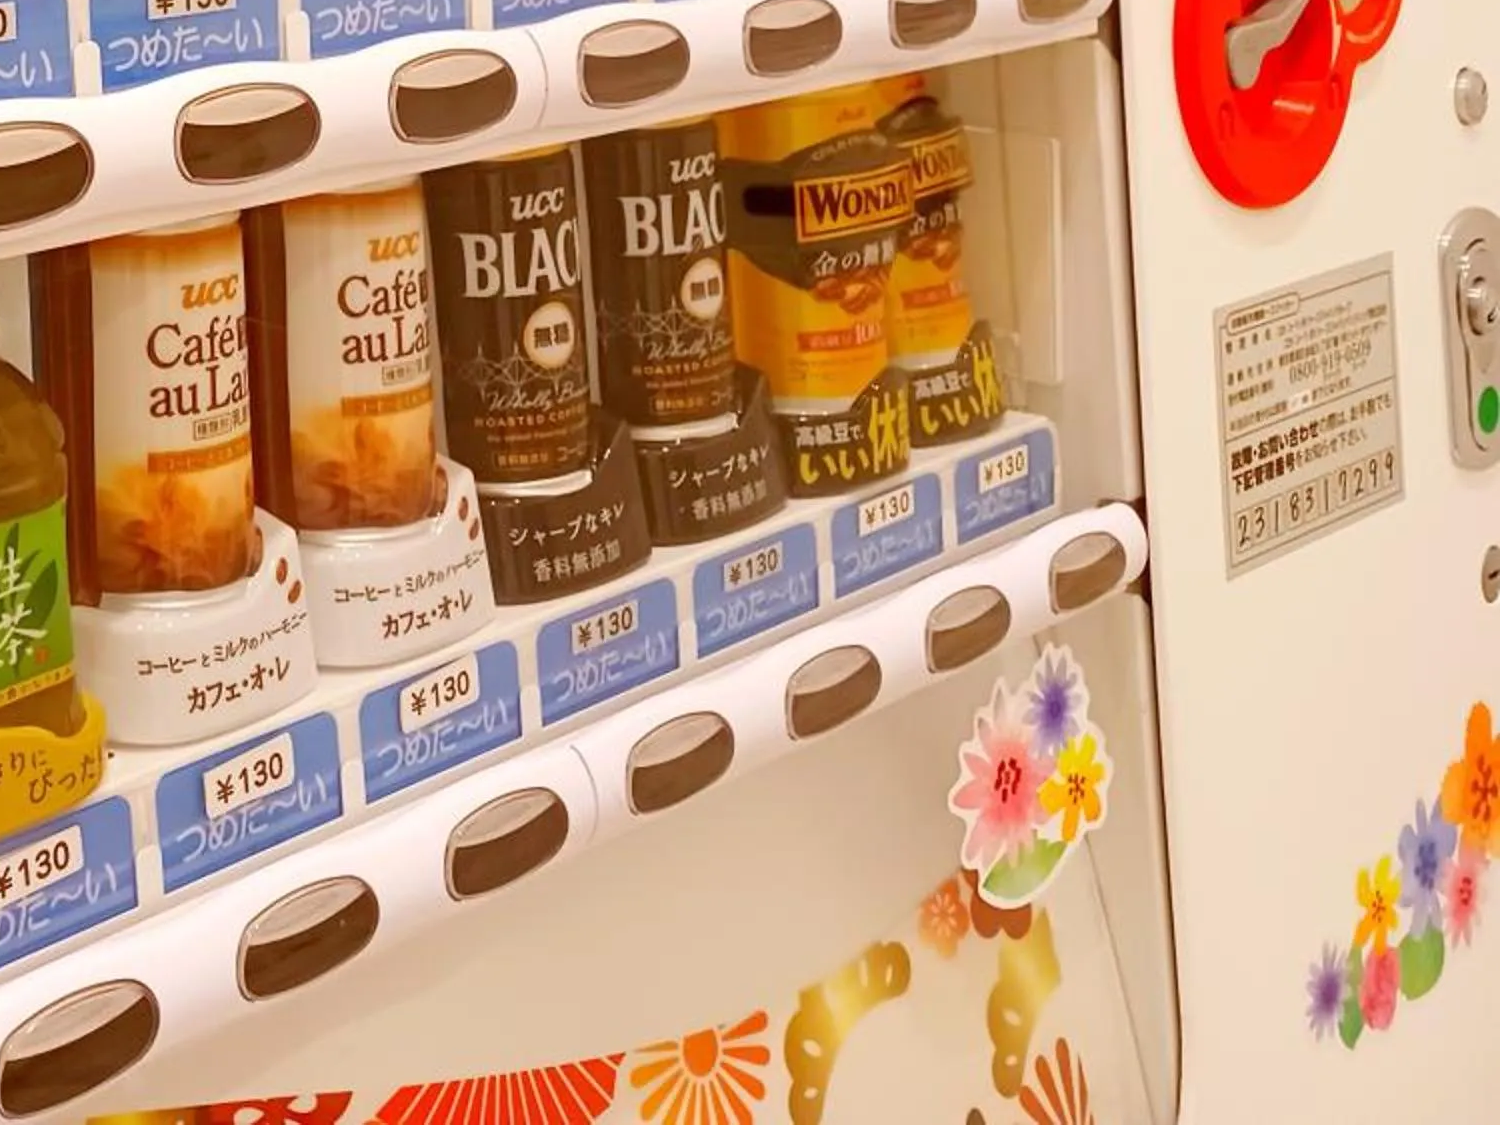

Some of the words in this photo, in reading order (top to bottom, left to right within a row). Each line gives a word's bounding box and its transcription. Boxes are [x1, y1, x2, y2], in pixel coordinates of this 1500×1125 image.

[337, 269, 417, 319] Café
[146, 314, 233, 369] Café
[341, 331, 388, 365] au
[149, 378, 200, 418] au
[576, 606, 634, 648] ¥130
[410, 669, 470, 716] ¥130
[216, 752, 284, 804] ¥130
